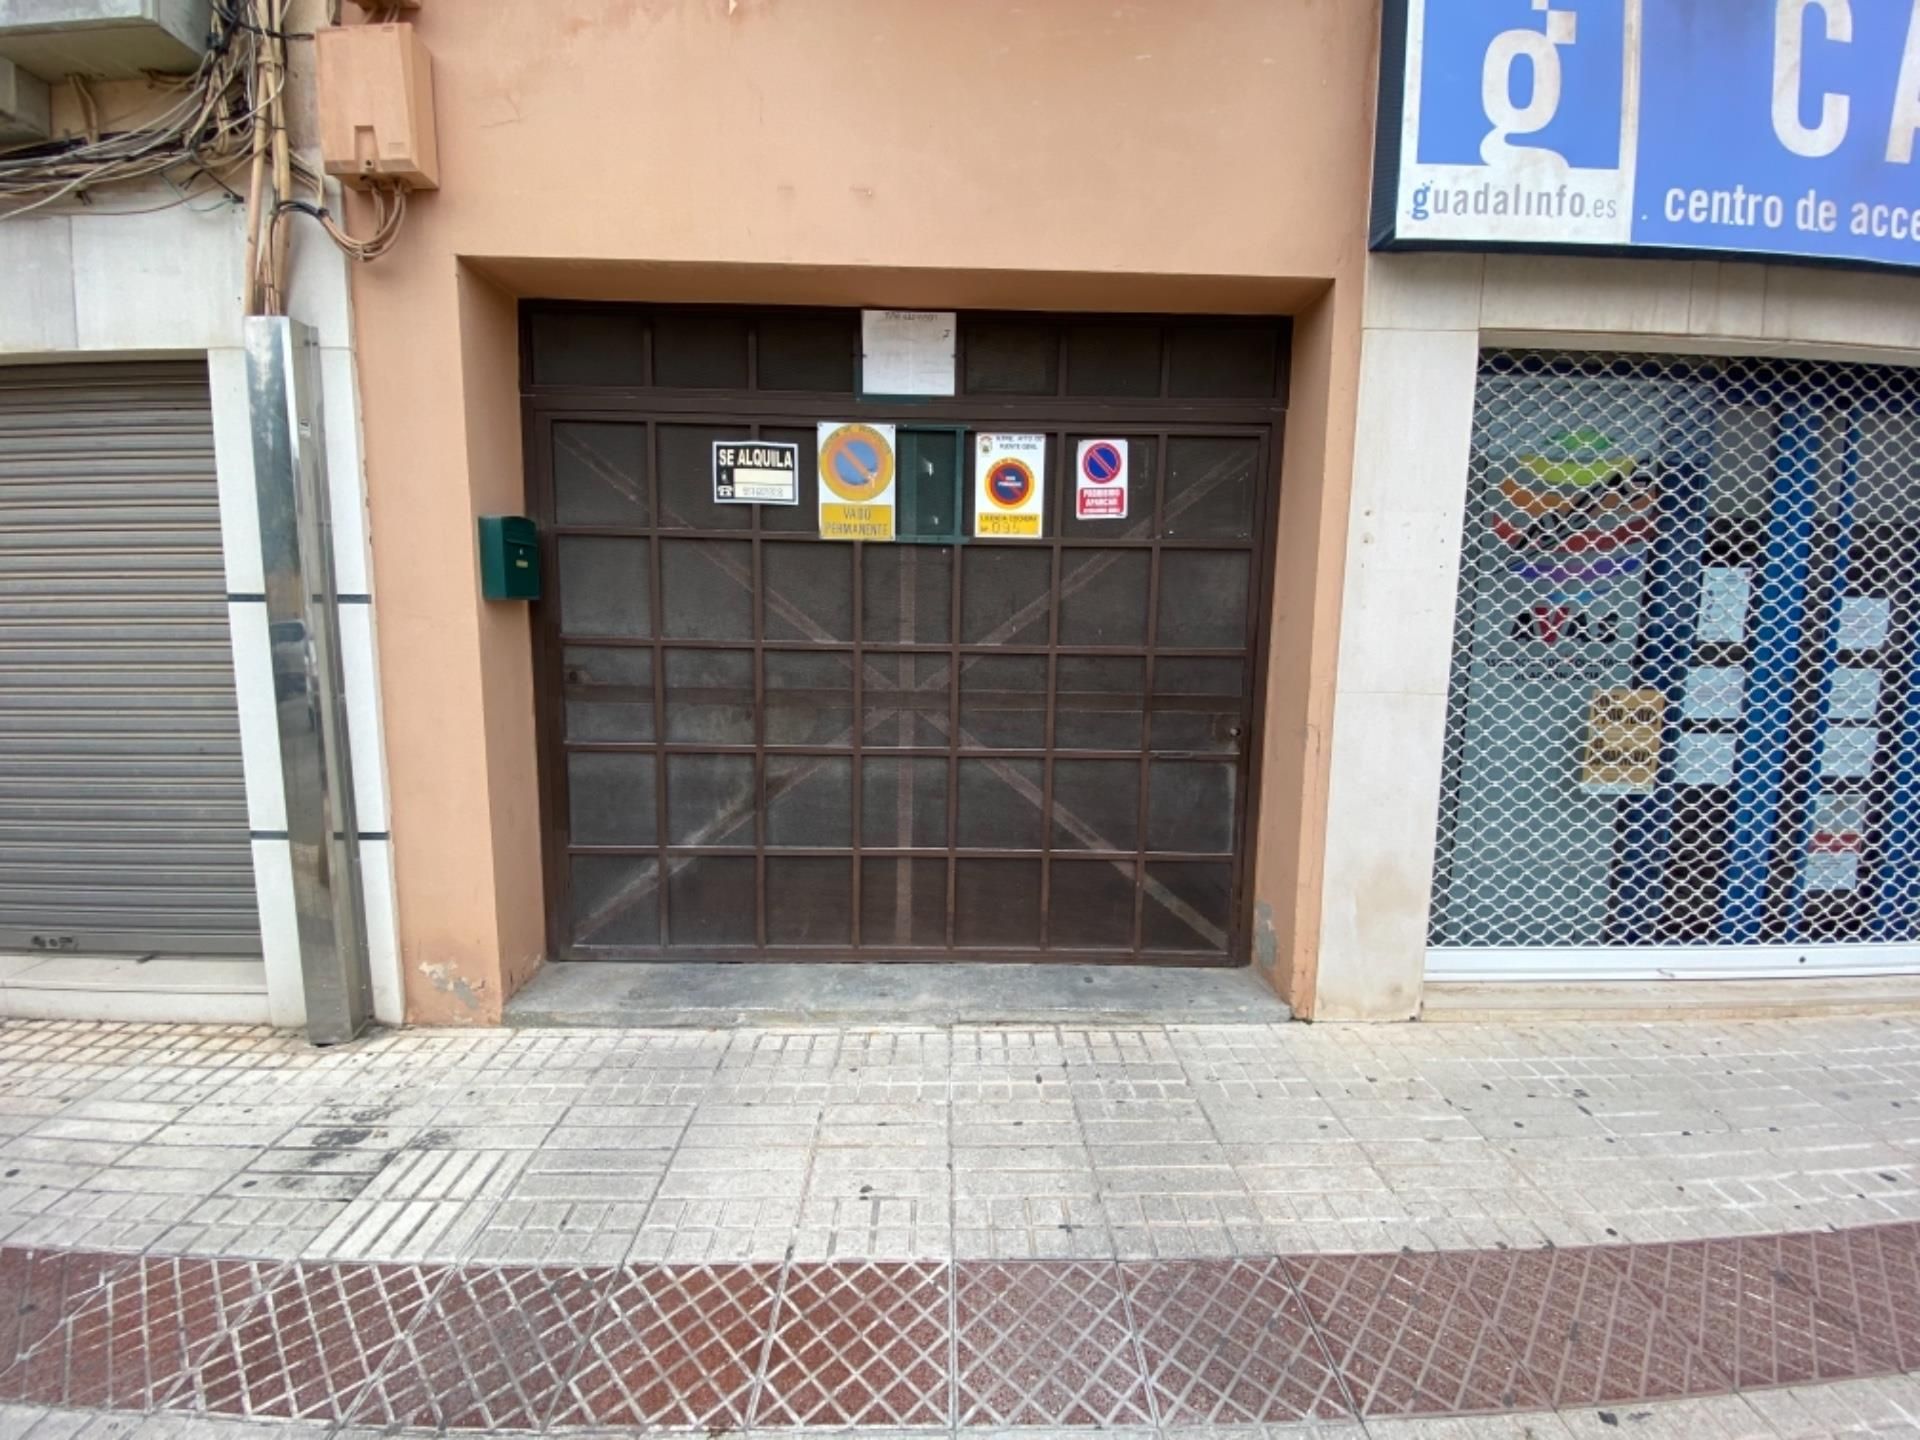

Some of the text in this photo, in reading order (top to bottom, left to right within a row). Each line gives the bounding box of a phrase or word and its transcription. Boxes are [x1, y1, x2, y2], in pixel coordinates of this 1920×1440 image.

[1411, 180, 1617, 220] guadalinfo.es
[1664, 184, 1784, 228] centro
[1796, 189, 1838, 232] de
[719, 449, 793, 469] SE ALQUILA
[827, 522, 889, 537] PERMANENTE
